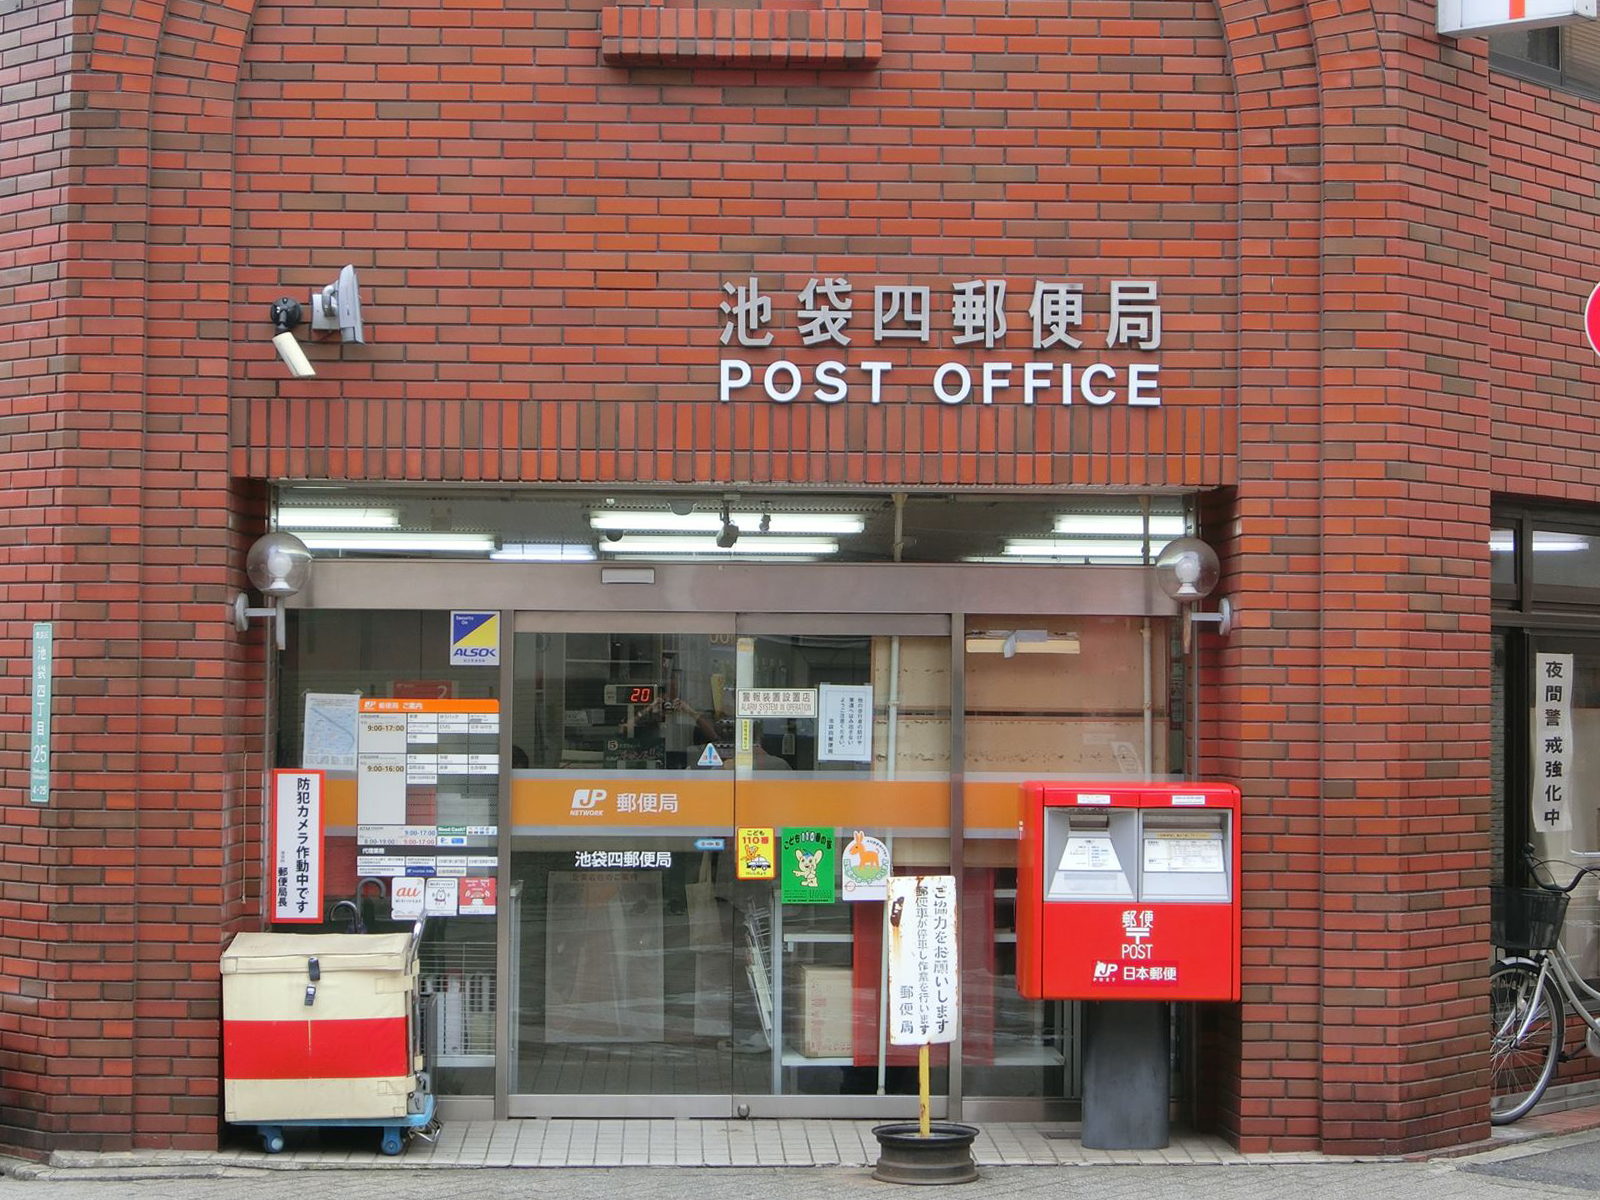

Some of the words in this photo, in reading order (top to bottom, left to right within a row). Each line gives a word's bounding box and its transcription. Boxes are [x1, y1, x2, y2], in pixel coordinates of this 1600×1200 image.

[719, 277, 1162, 350] 池袋四郵便局
[719, 359, 892, 404] POST
[933, 361, 1161, 406] OFFICE
[454, 648, 497, 657] ALSOK
[630, 688, 652, 702] 20
[742, 692, 811, 702] 警報装置設置店
[758, 703, 778, 711] SYSTEM
[786, 703, 811, 711] OPERATION
[1544, 661, 1563, 827] 夜間警戒強化中
[33, 744, 47, 763] 25
[617, 793, 679, 813] 郵便局
[296, 777, 310, 914] 防犯カメラ作動中です
[574, 851, 672, 868] 池袋四郵便局
[277, 867, 288, 907] 郵便局長
[396, 886, 420, 898] au
[1122, 910, 1154, 928] 郵便
[933, 886, 951, 1034] ご協力をお願いします
[1121, 944, 1153, 959] POST
[1123, 967, 1177, 981] 日本郵便
[899, 985, 914, 1035] 郵便局
